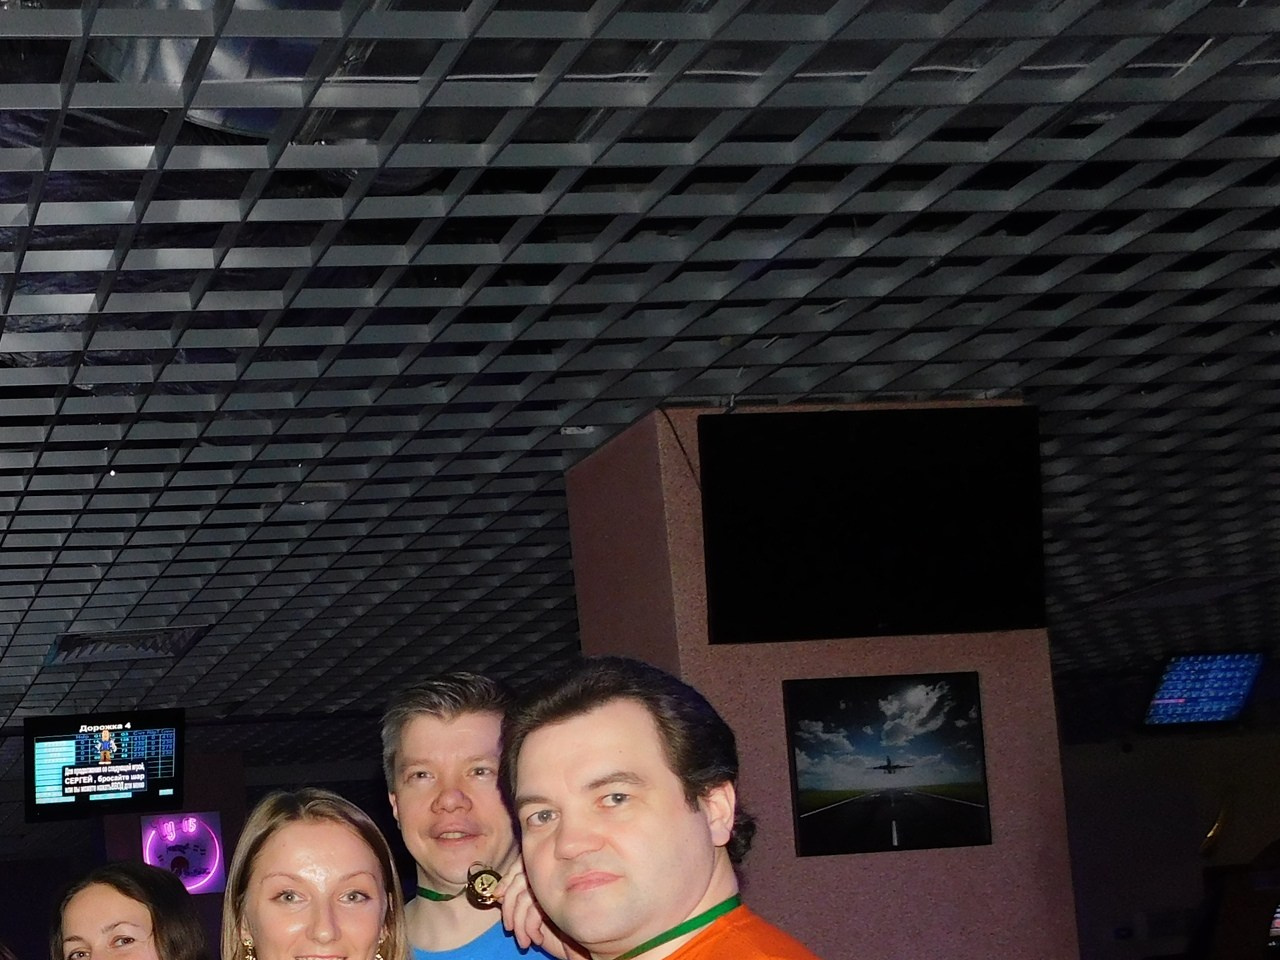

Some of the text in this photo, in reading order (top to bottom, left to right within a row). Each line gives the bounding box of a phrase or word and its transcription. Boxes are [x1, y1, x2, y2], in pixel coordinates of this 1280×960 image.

[79, 724, 123, 733] Дорожка
[65, 775, 93, 784] СЕРГЕЙ
[97, 774, 129, 783] бросайте
